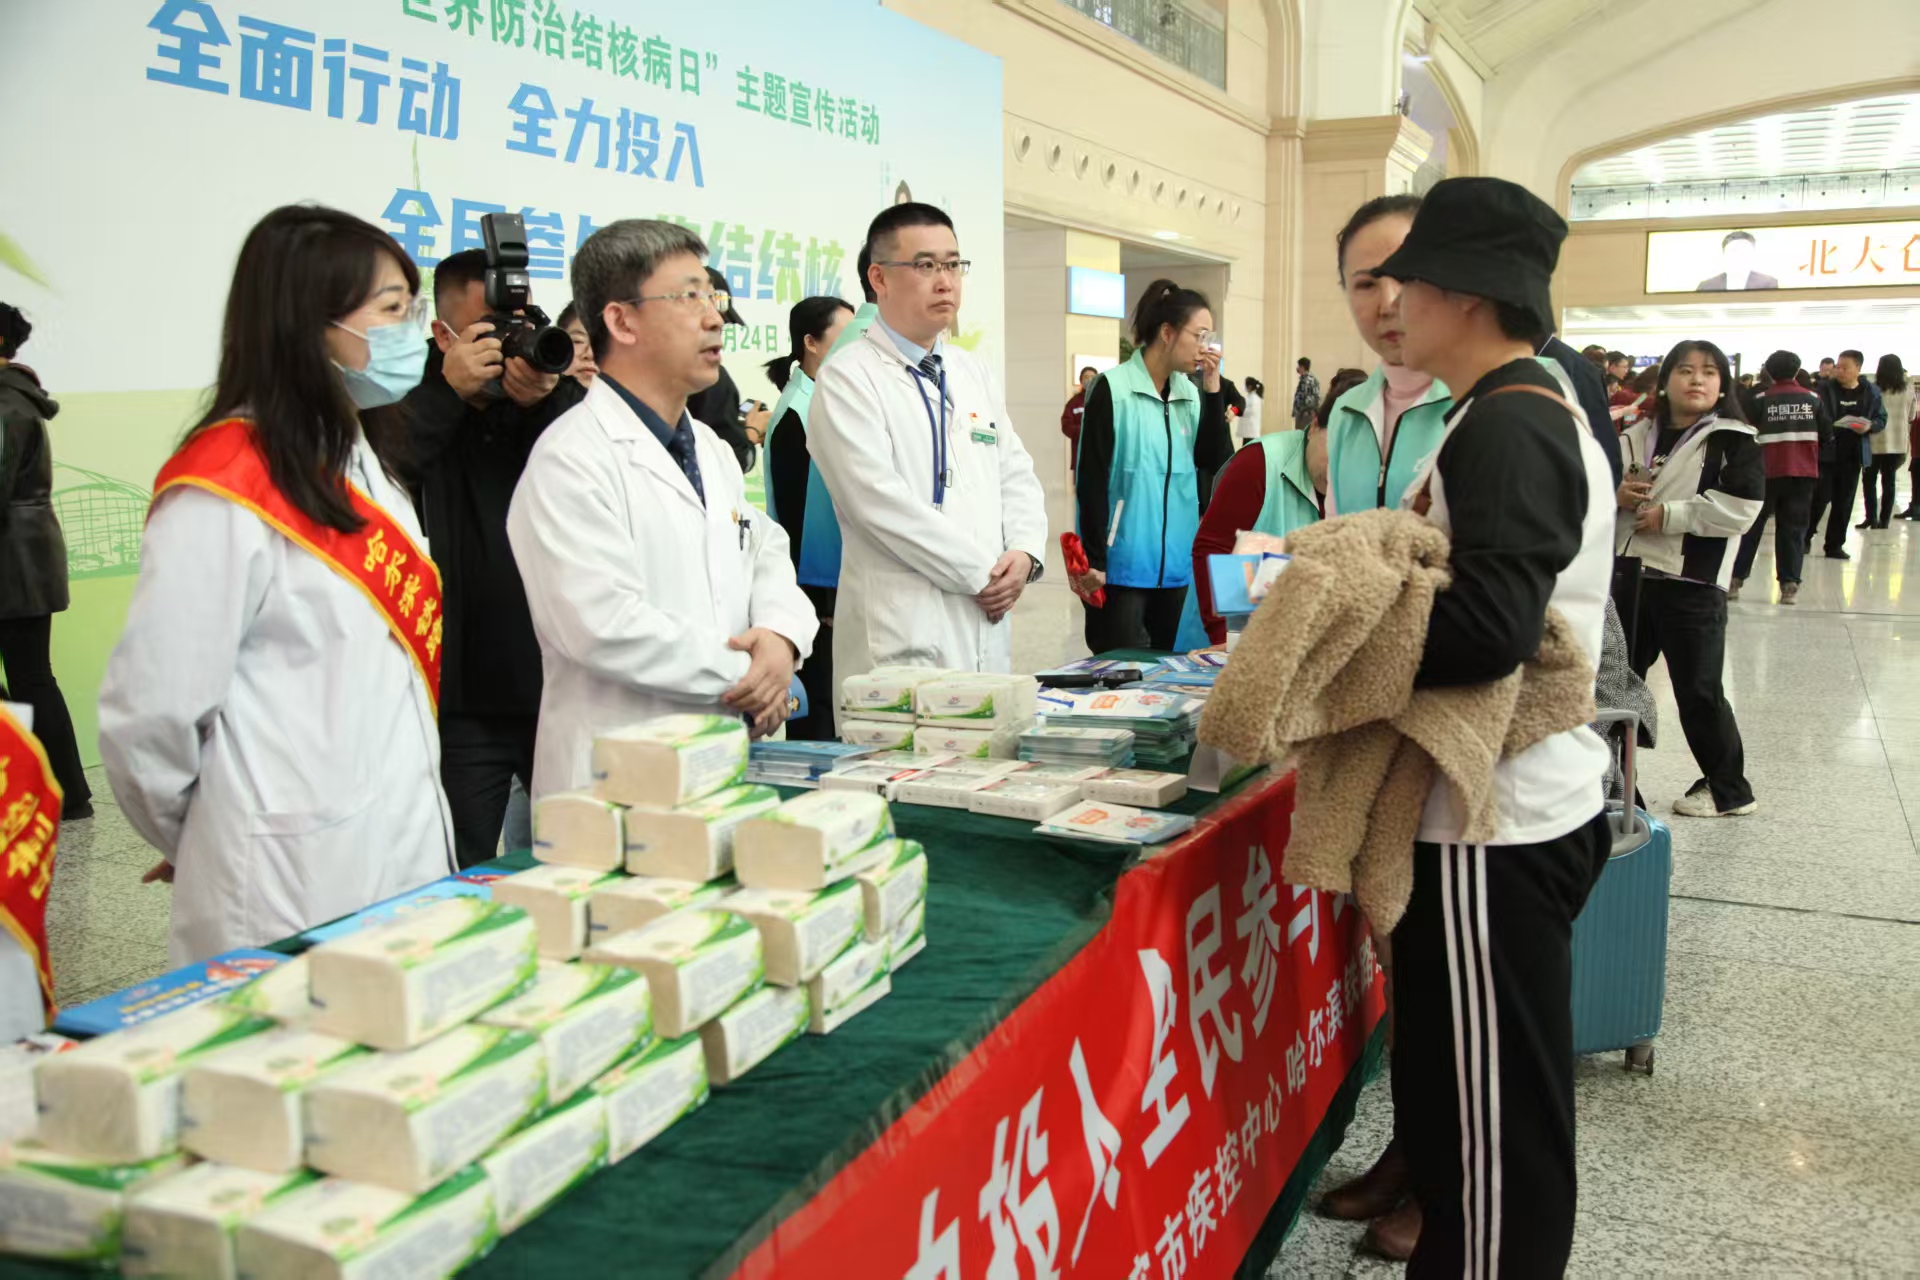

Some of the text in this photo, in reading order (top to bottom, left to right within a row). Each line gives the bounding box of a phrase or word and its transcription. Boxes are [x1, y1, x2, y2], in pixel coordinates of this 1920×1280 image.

[146, 0, 705, 188] 全面行动 全力投入
[736, 65, 880, 145] 主题宣传活动
[656, 213, 845, 305] 结结核
[1767, 403, 1813, 416] 中国卫生
[1128, 934, 1383, 1280] 市疾控中心 哈尔滨铁路
